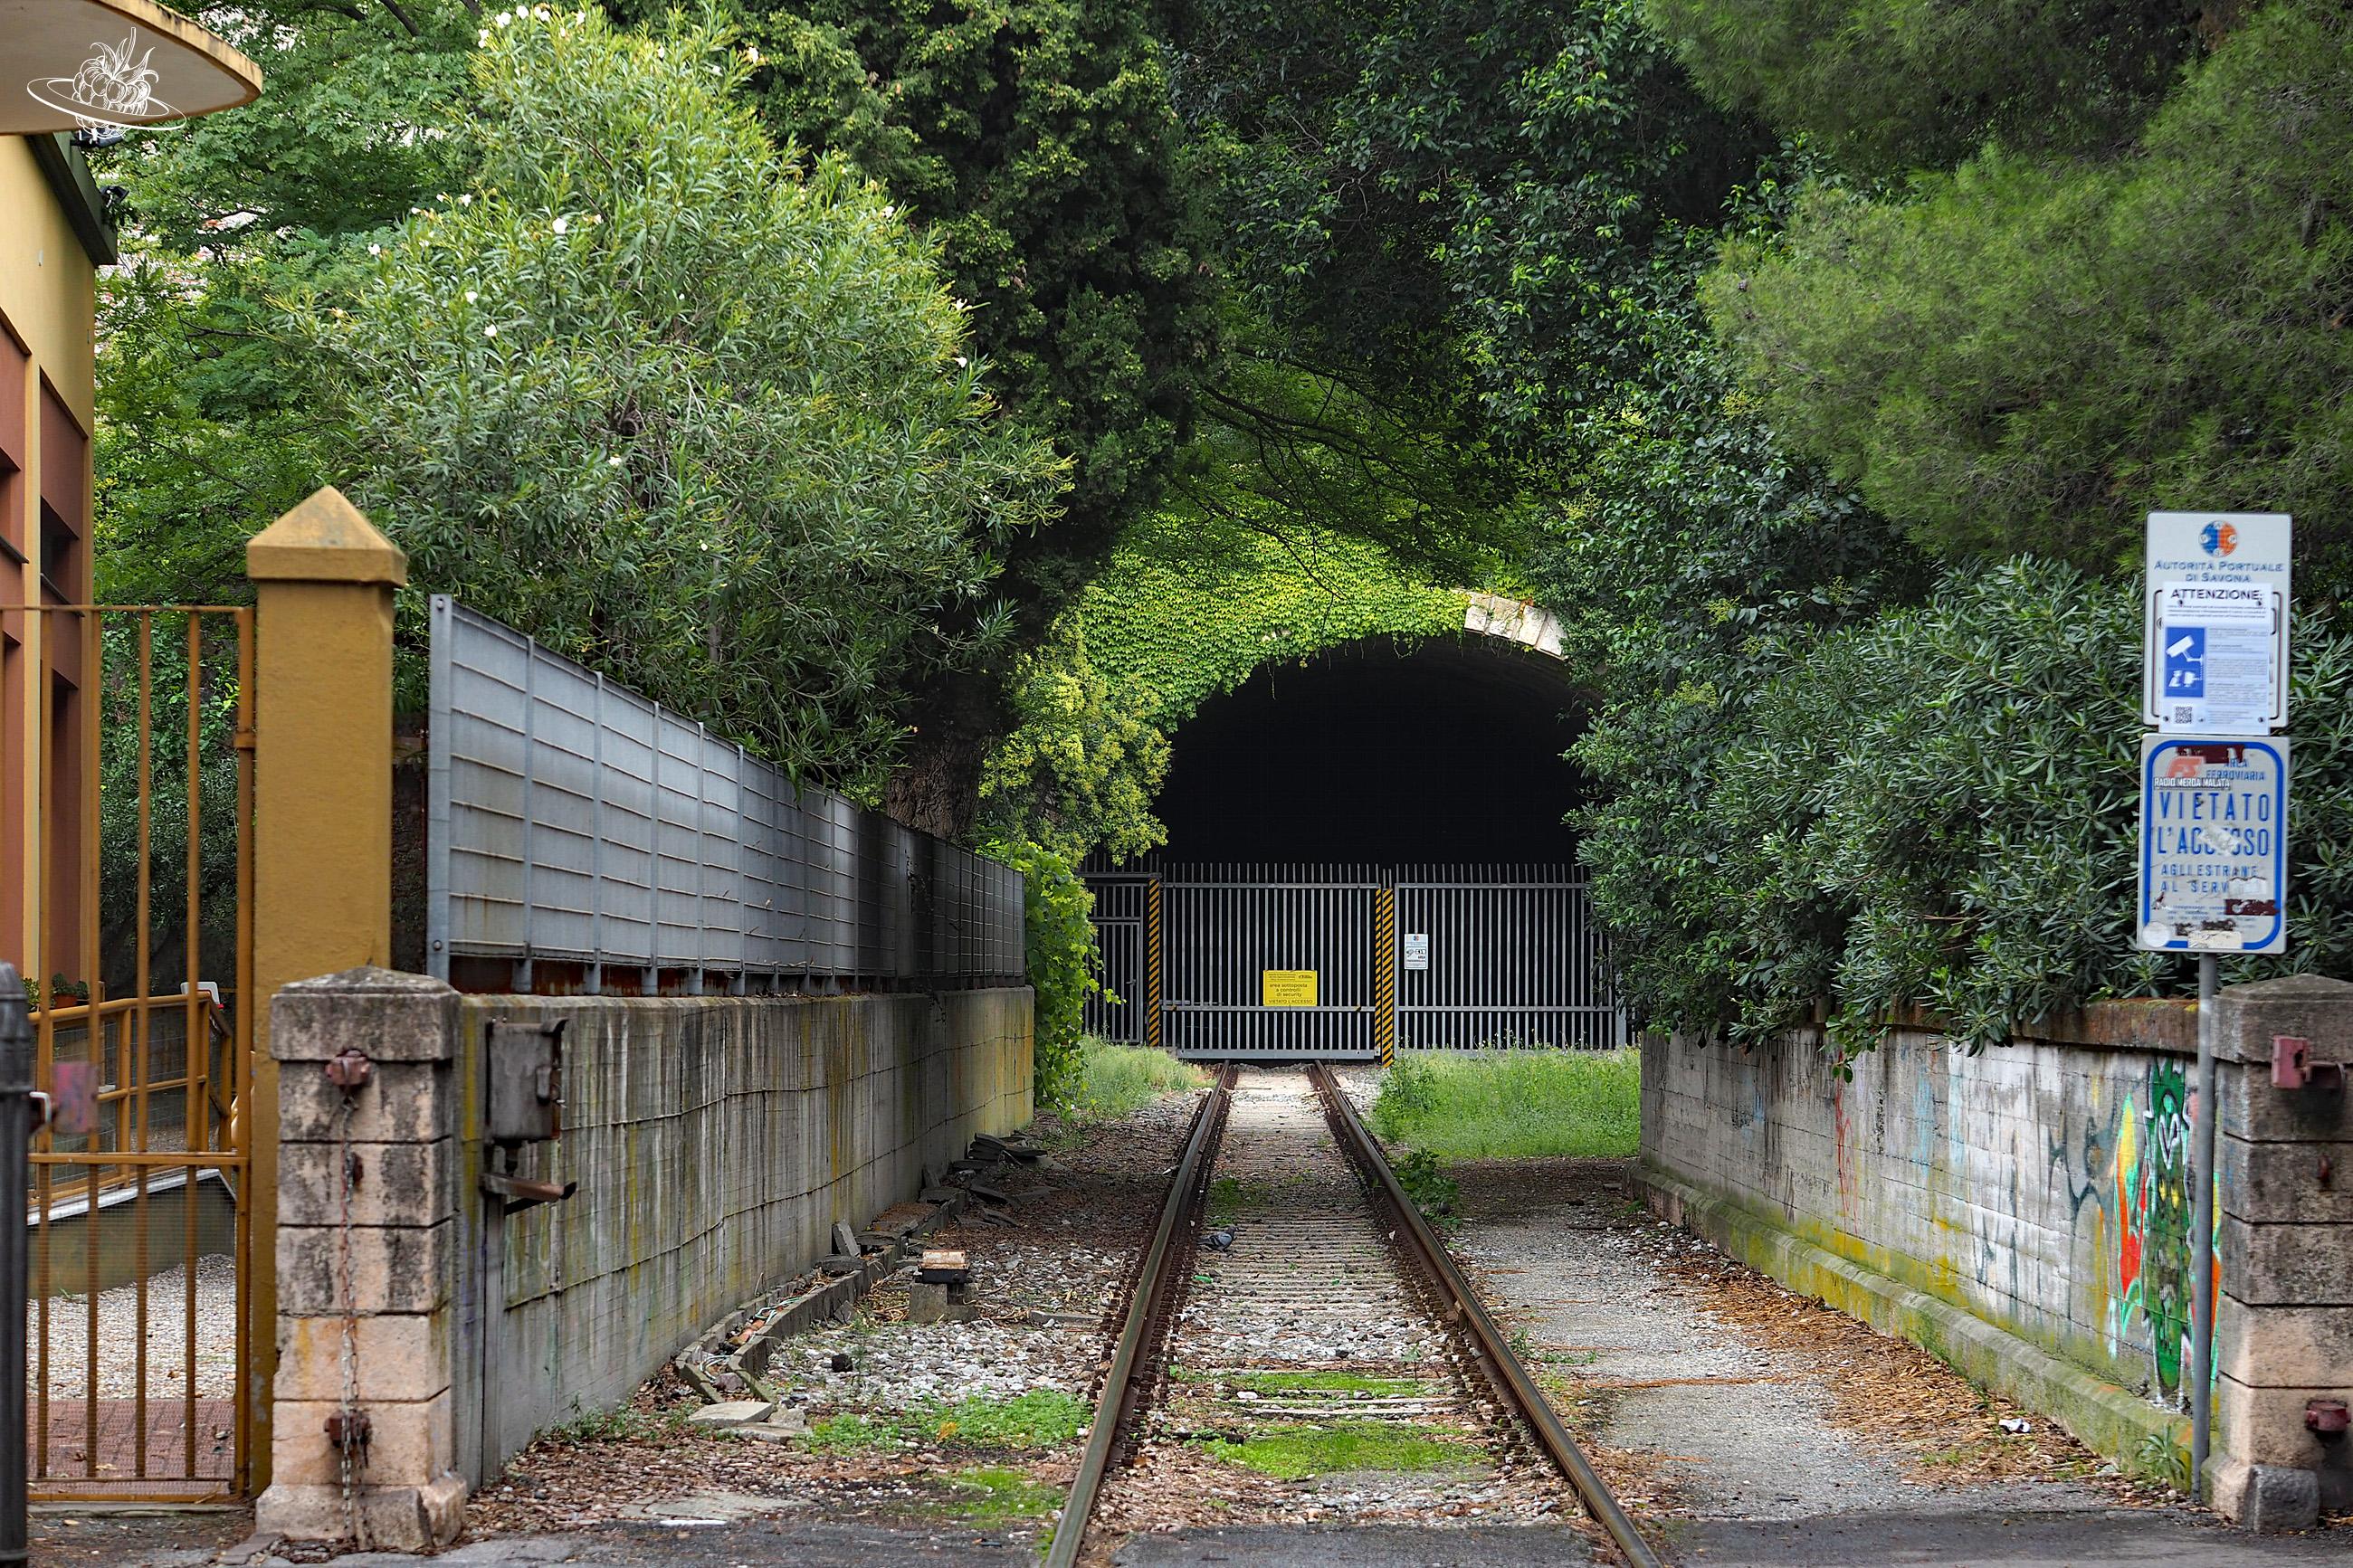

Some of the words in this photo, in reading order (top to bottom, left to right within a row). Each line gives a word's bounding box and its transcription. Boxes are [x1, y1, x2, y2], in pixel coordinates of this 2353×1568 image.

[2219, 561, 2283, 572] PORTUALE
[2186, 574, 2197, 582] DI
[2201, 573, 2252, 583] SAVONA
[2154, 778, 2176, 787] RADIO
[2159, 792, 2271, 822] VIETATO
[2157, 827, 2270, 856] L'ACSSO
[2160, 881, 2177, 892] AL
